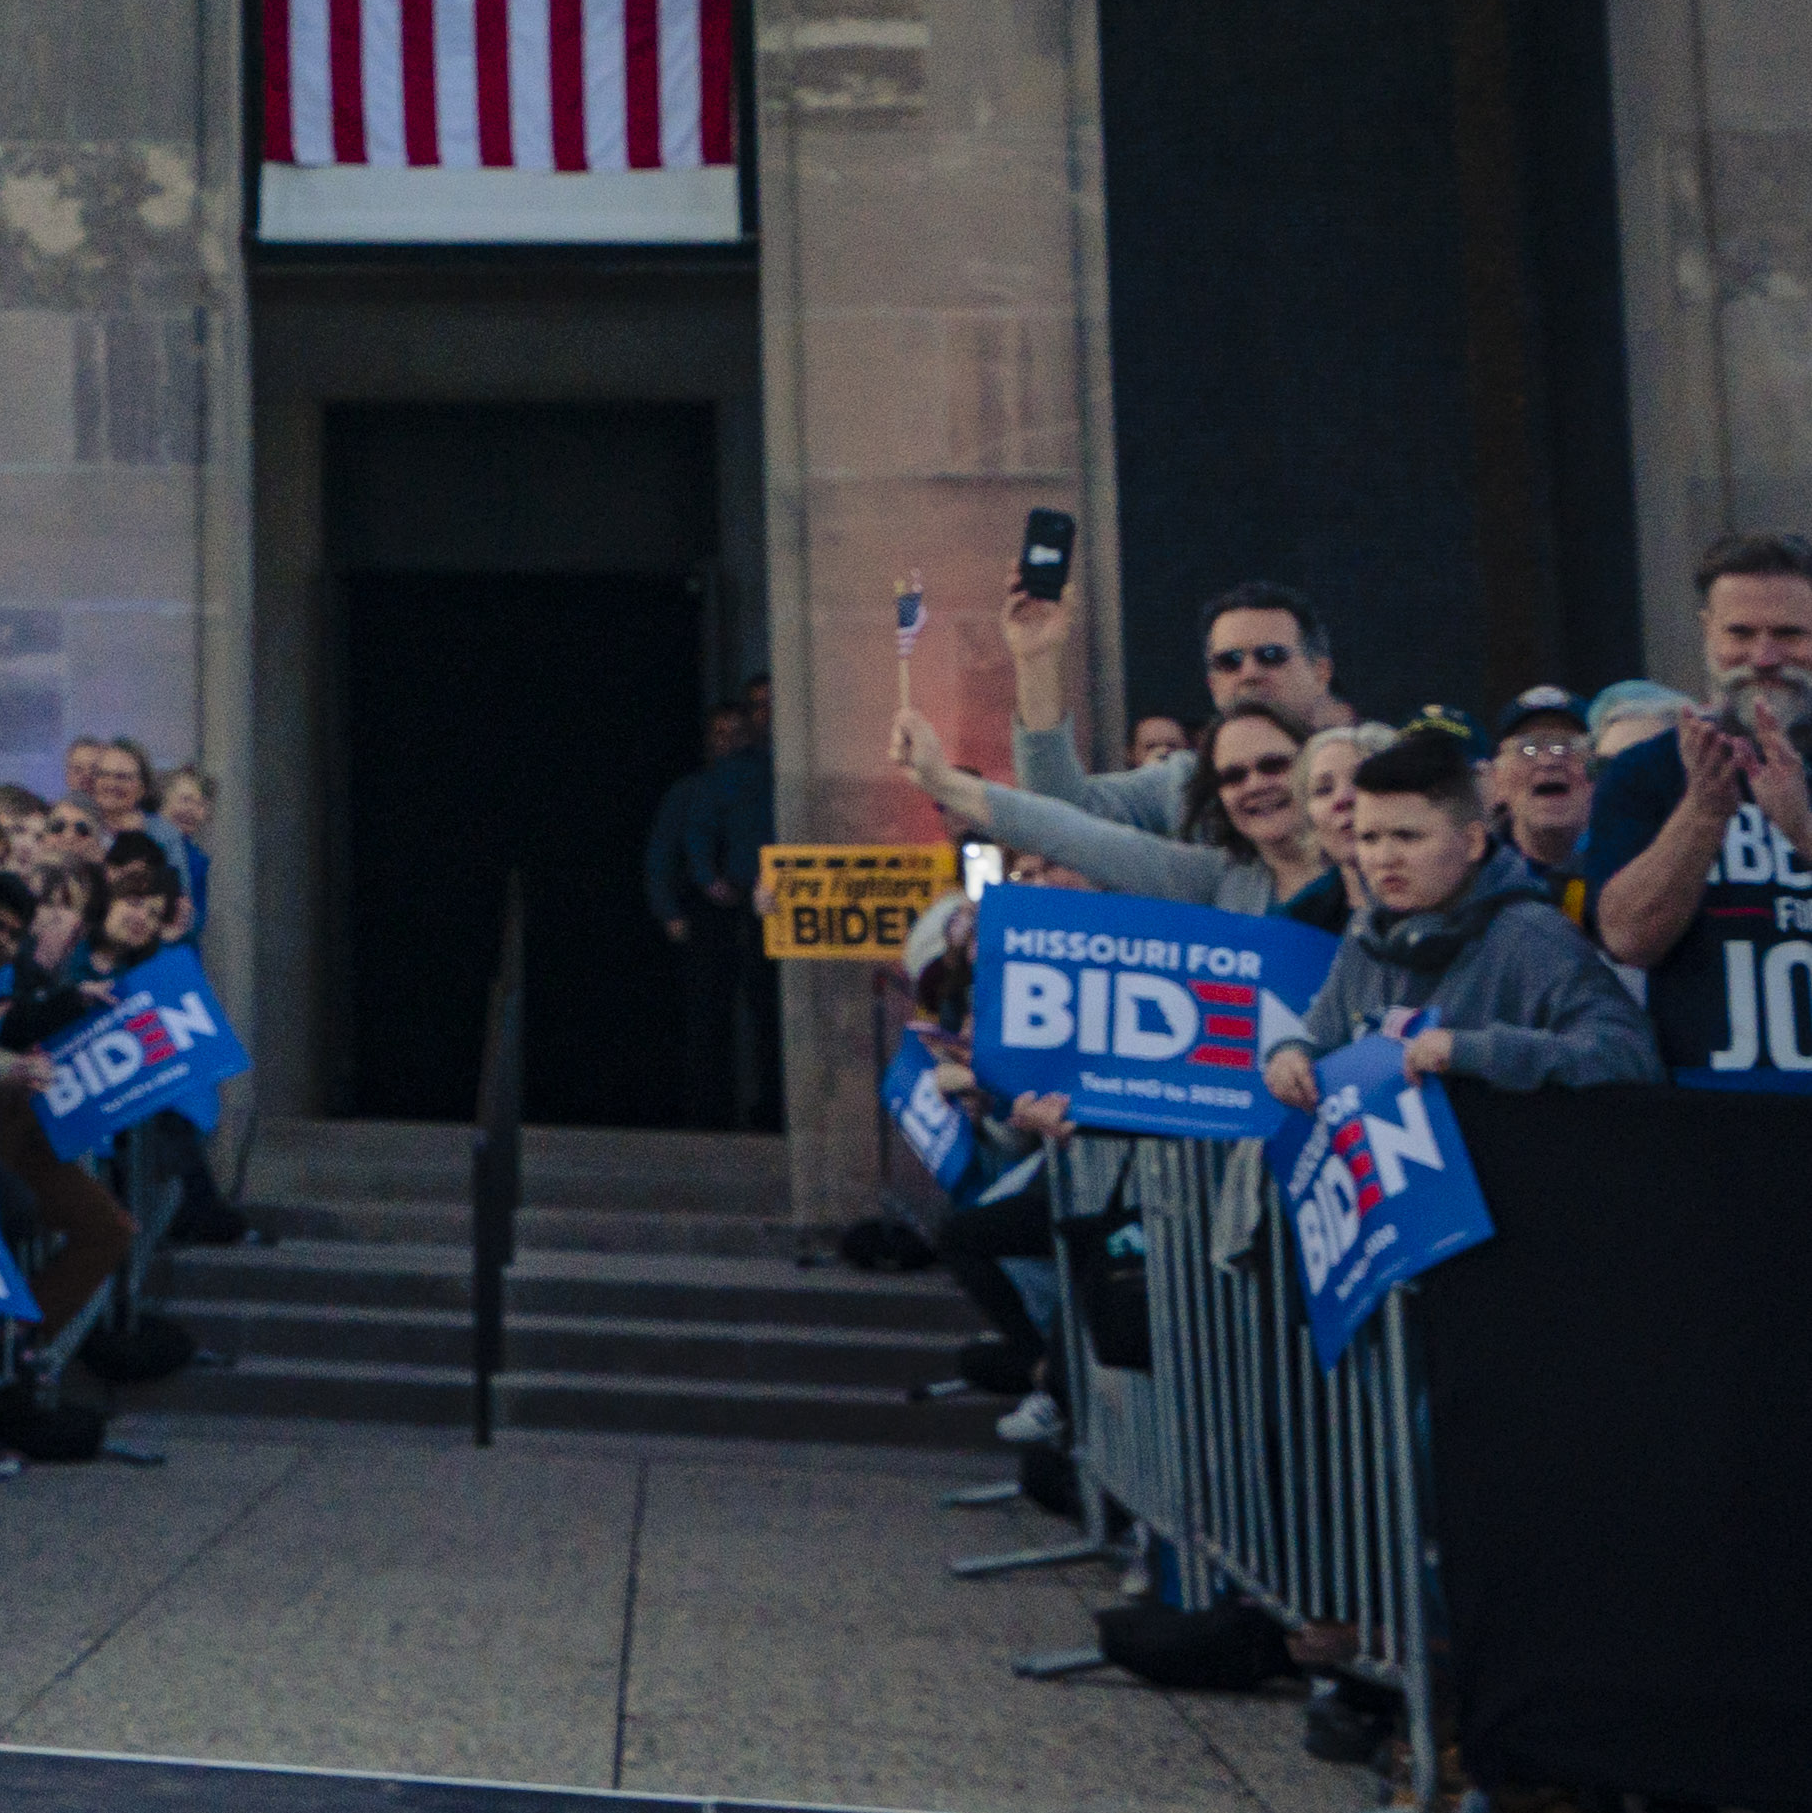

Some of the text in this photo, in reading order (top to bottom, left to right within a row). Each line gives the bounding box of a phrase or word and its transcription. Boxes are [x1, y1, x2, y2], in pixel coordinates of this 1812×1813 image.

[1003, 927, 1262, 979] MISSOURI FOR
[45, 991, 218, 1119] BIDEN
[1296, 1087, 1446, 1296] BIDEN
